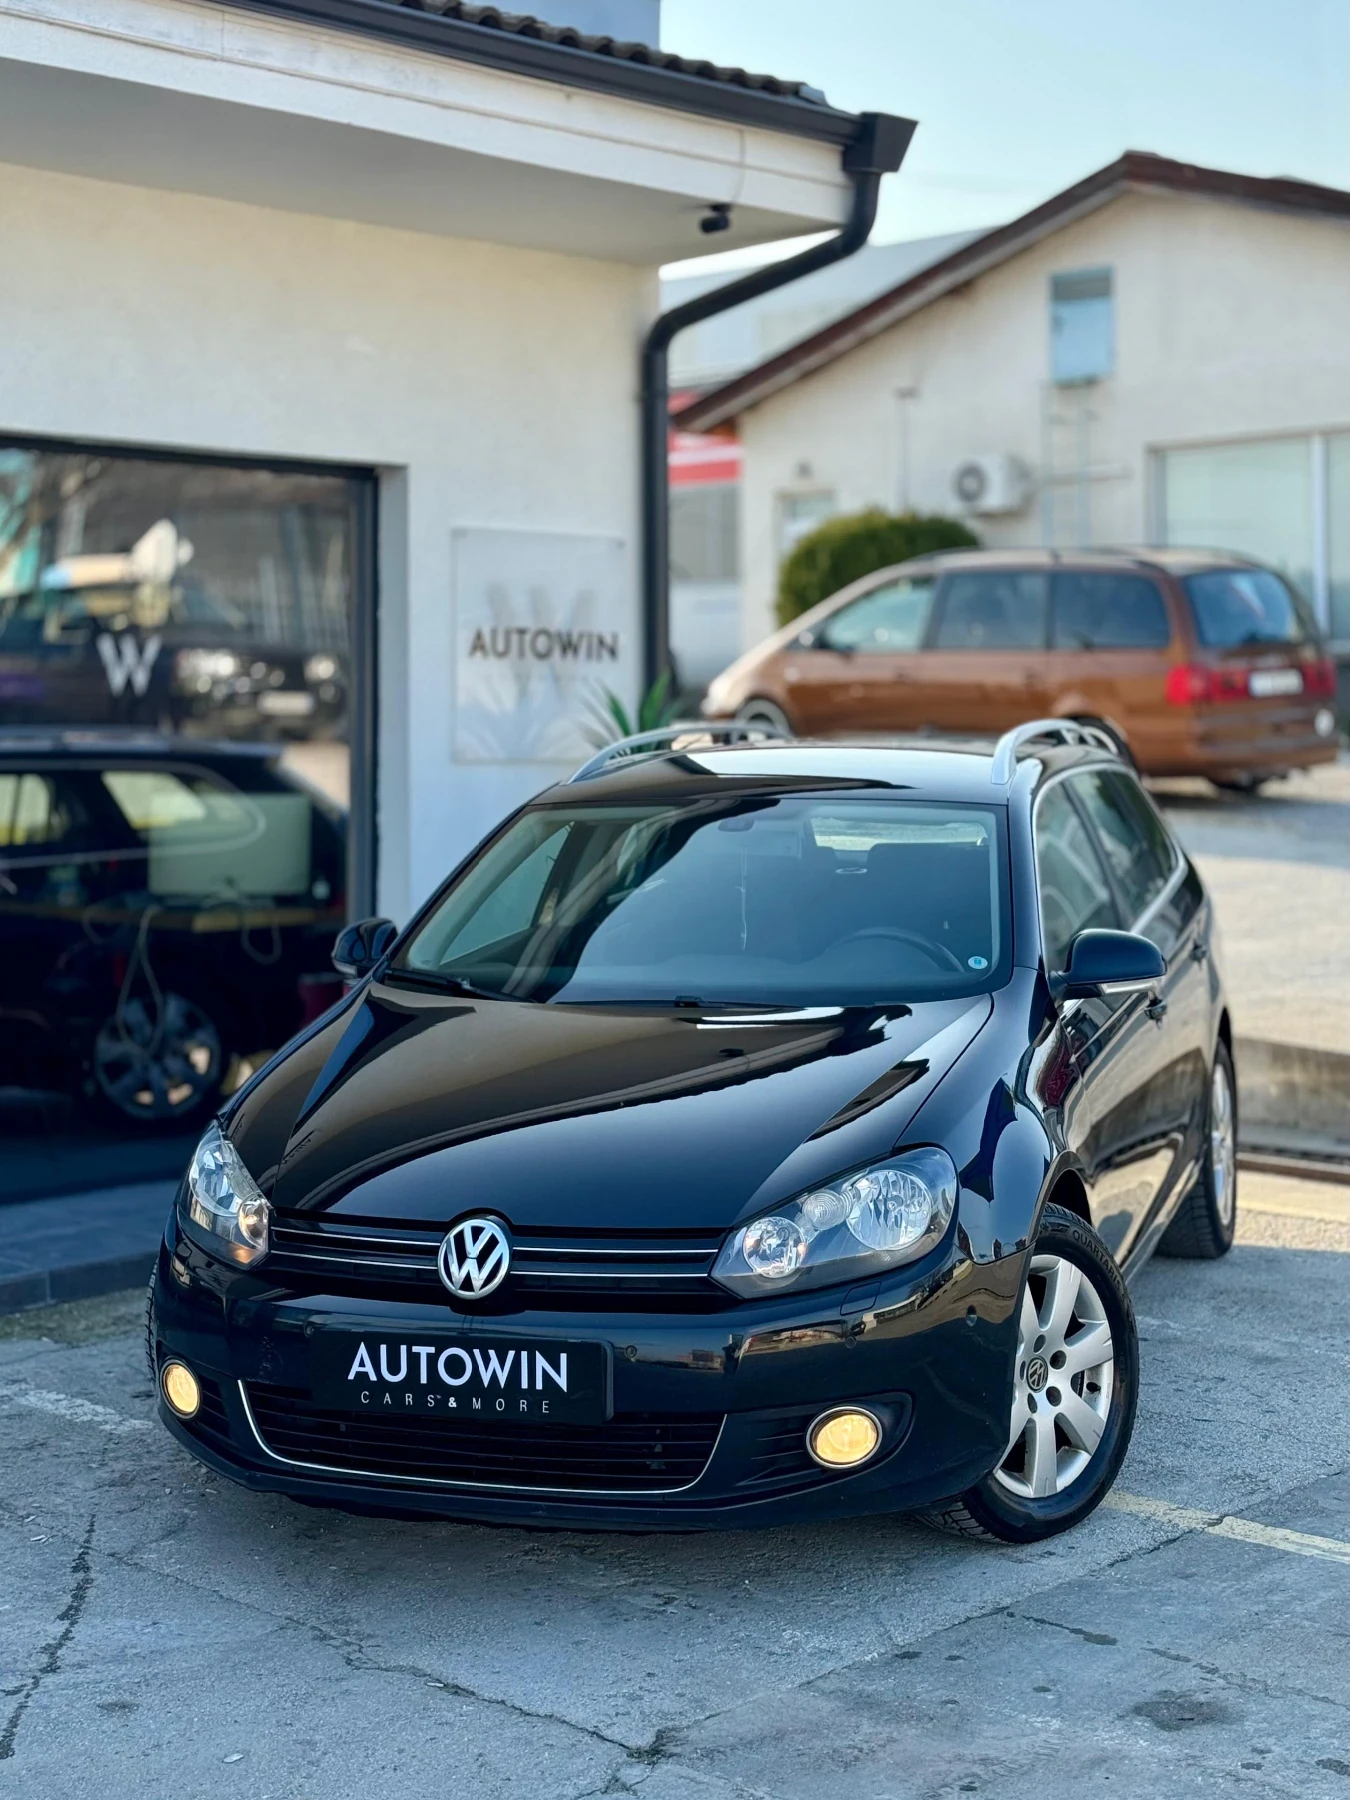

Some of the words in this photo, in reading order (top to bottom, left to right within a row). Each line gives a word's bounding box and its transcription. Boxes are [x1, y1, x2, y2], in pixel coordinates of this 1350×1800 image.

[96, 633, 162, 697] W
[469, 626, 619, 661] AUTOWIN
[347, 1341, 567, 1393] AUTOWIN
[473, 1397, 550, 1413] MORE
